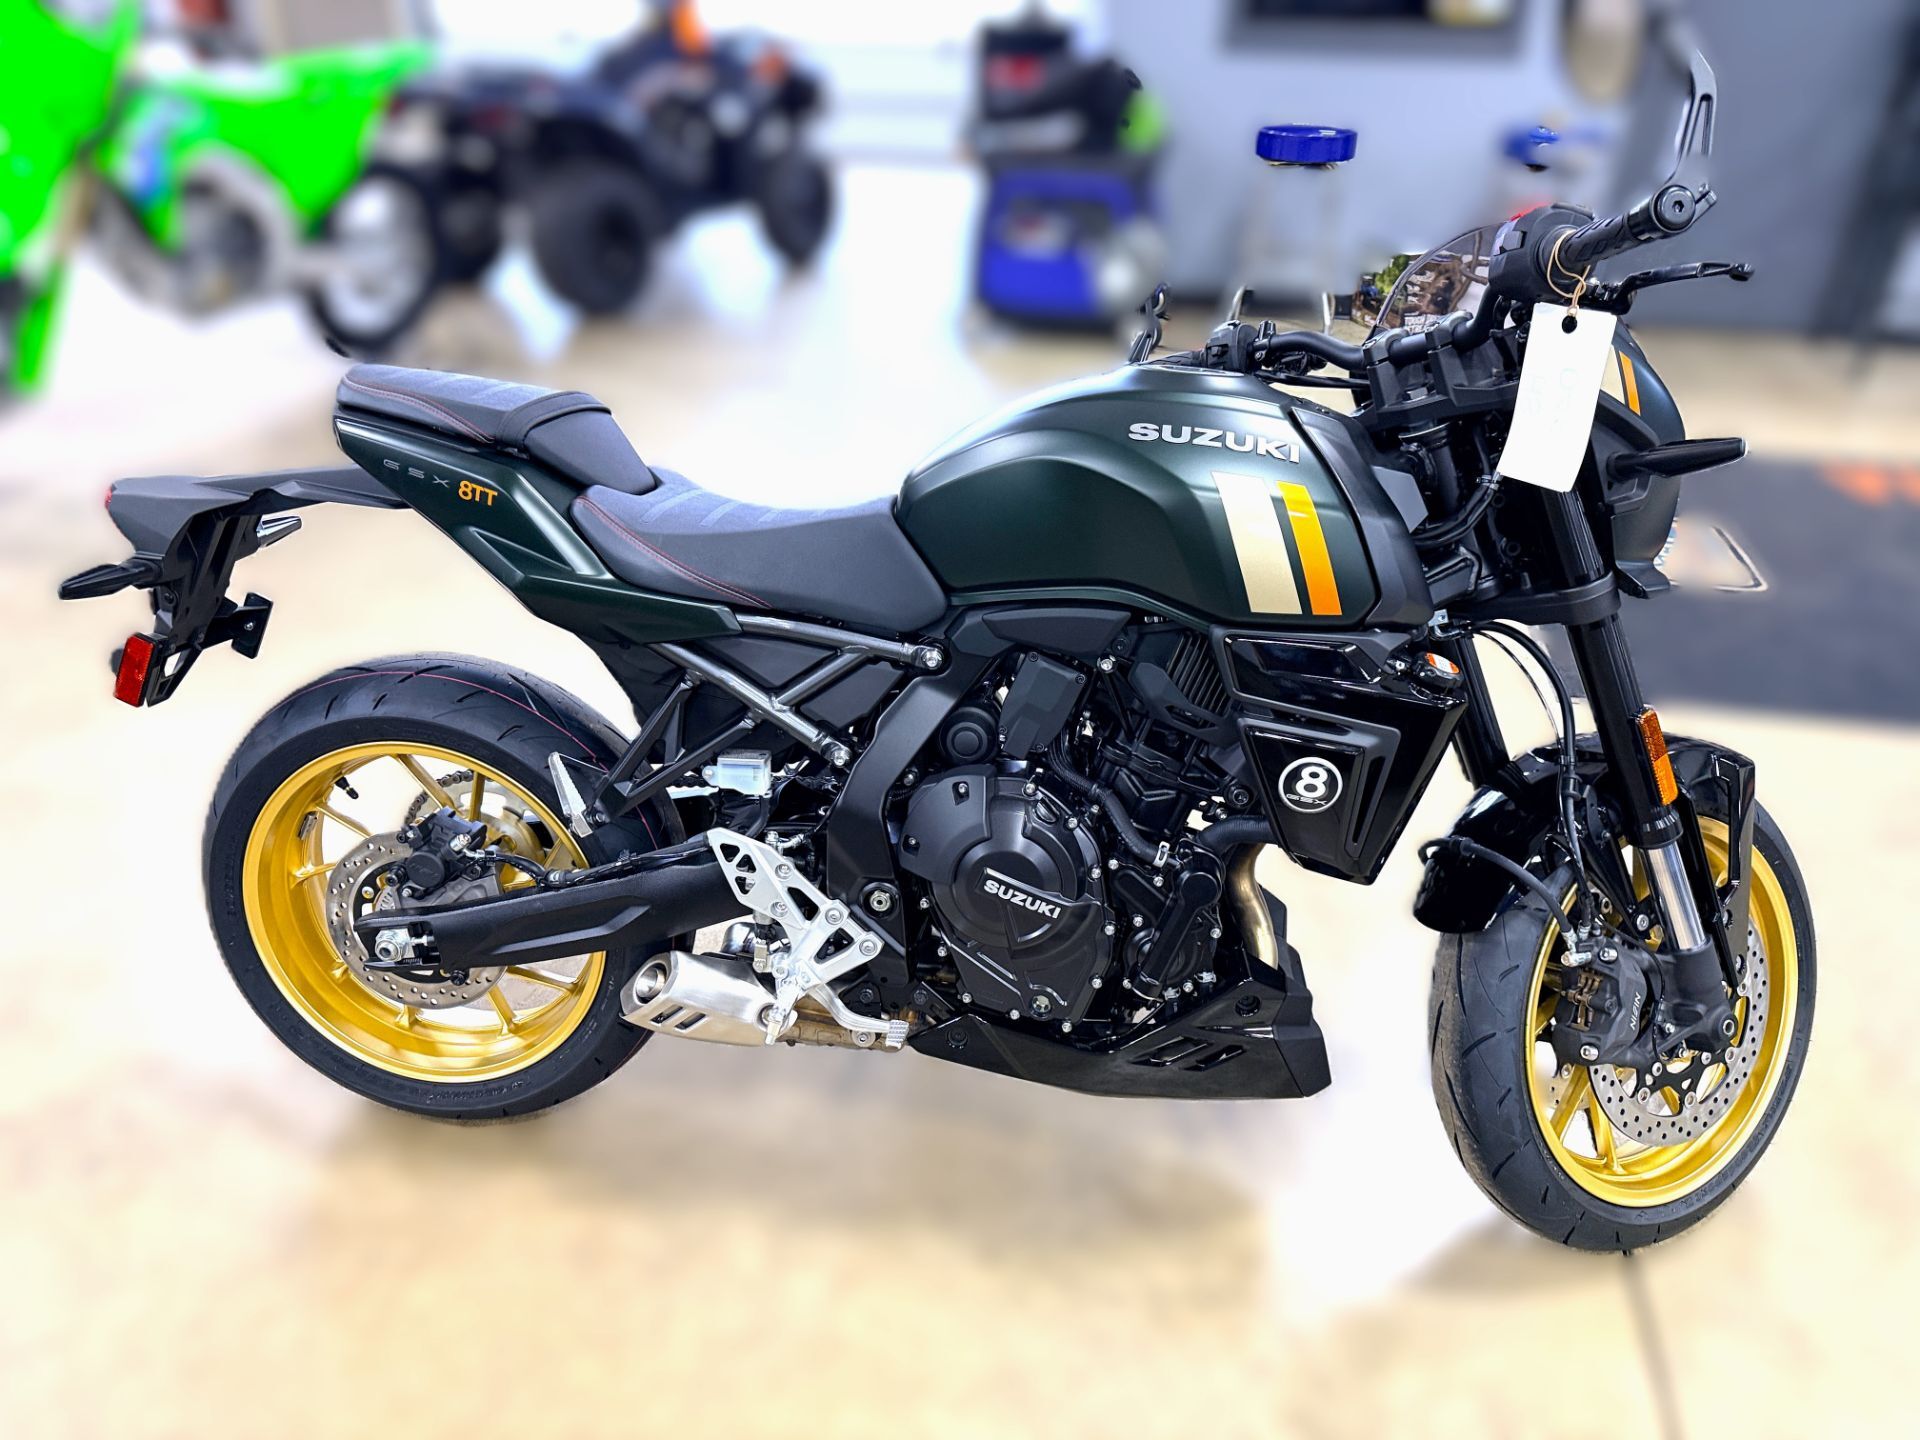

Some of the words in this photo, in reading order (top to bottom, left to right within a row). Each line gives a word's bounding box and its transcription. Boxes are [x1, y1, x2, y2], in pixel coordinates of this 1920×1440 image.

[1128, 422, 1300, 464] SUZUKI
[383, 459, 450, 488] GSX
[458, 480, 498, 506] 8TT
[1286, 793, 1328, 806] GSX
[1295, 765, 1328, 798] 8
[983, 879, 1062, 919] SUZUKI
